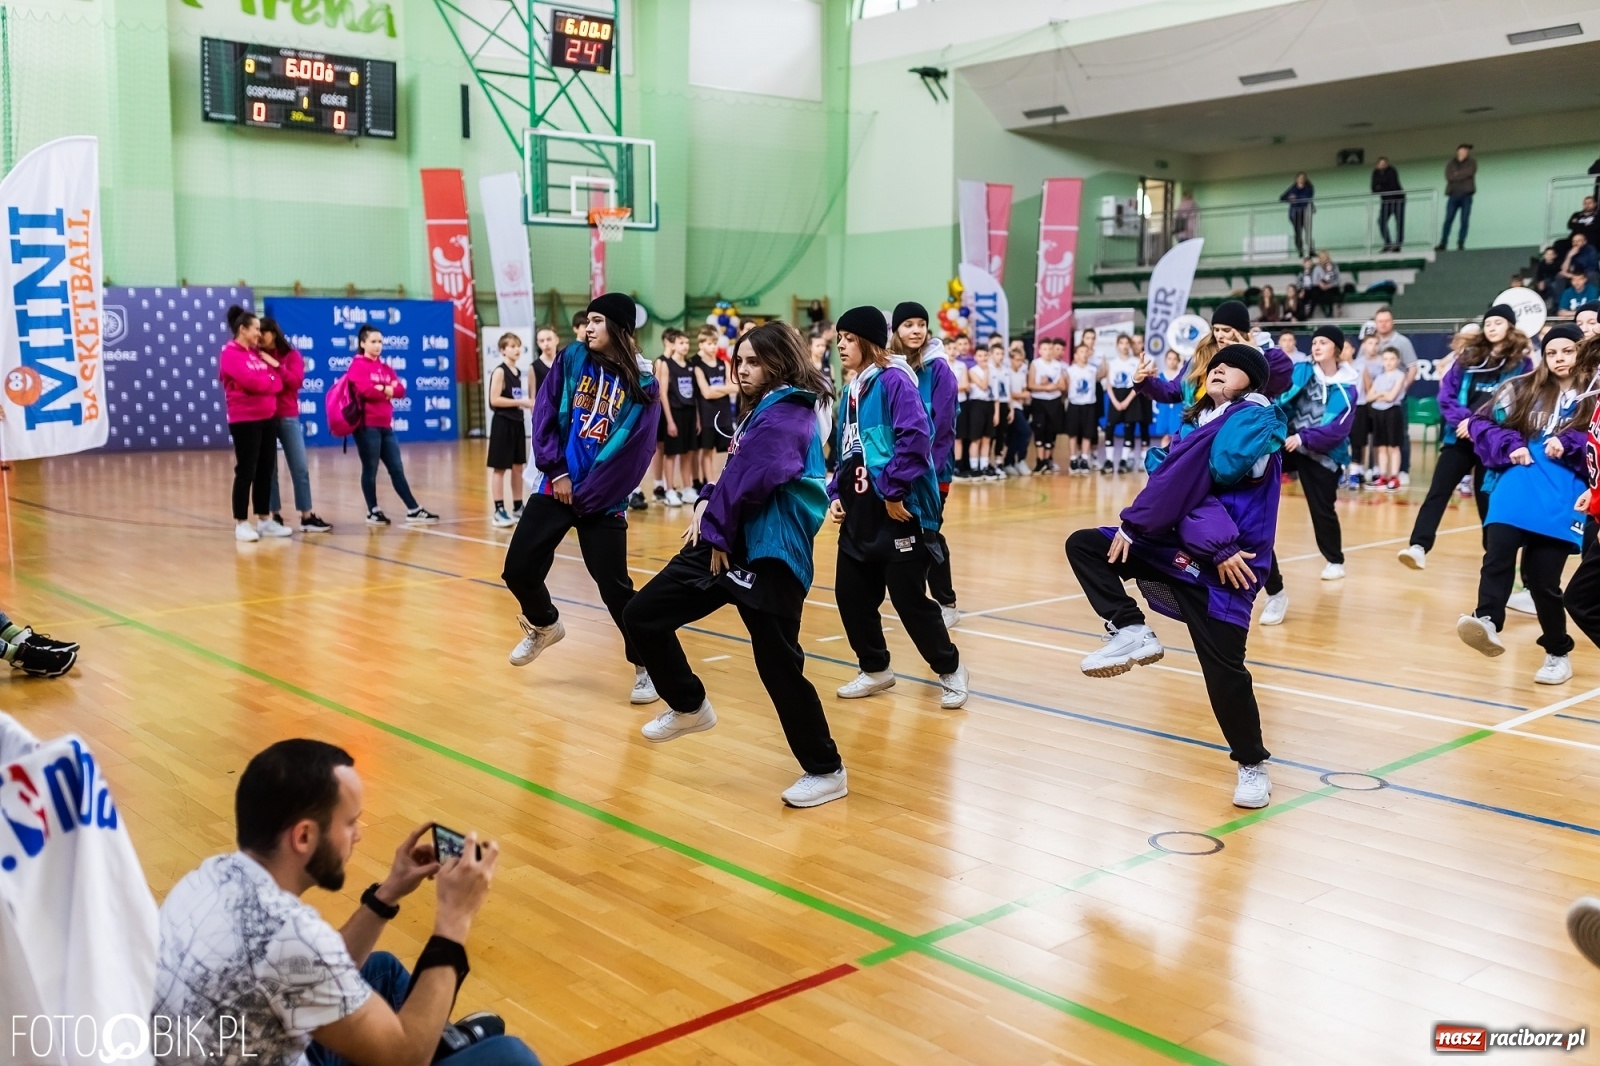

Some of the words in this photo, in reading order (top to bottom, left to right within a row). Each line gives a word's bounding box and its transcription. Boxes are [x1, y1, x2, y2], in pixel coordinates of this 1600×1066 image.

[565, 39, 598, 64] 24
[253, 102, 266, 121] 0
[333, 110, 346, 130] 0
[8, 206, 83, 431] MINI
[67, 208, 99, 424] BASKETBALL
[854, 466, 869, 494] 3
